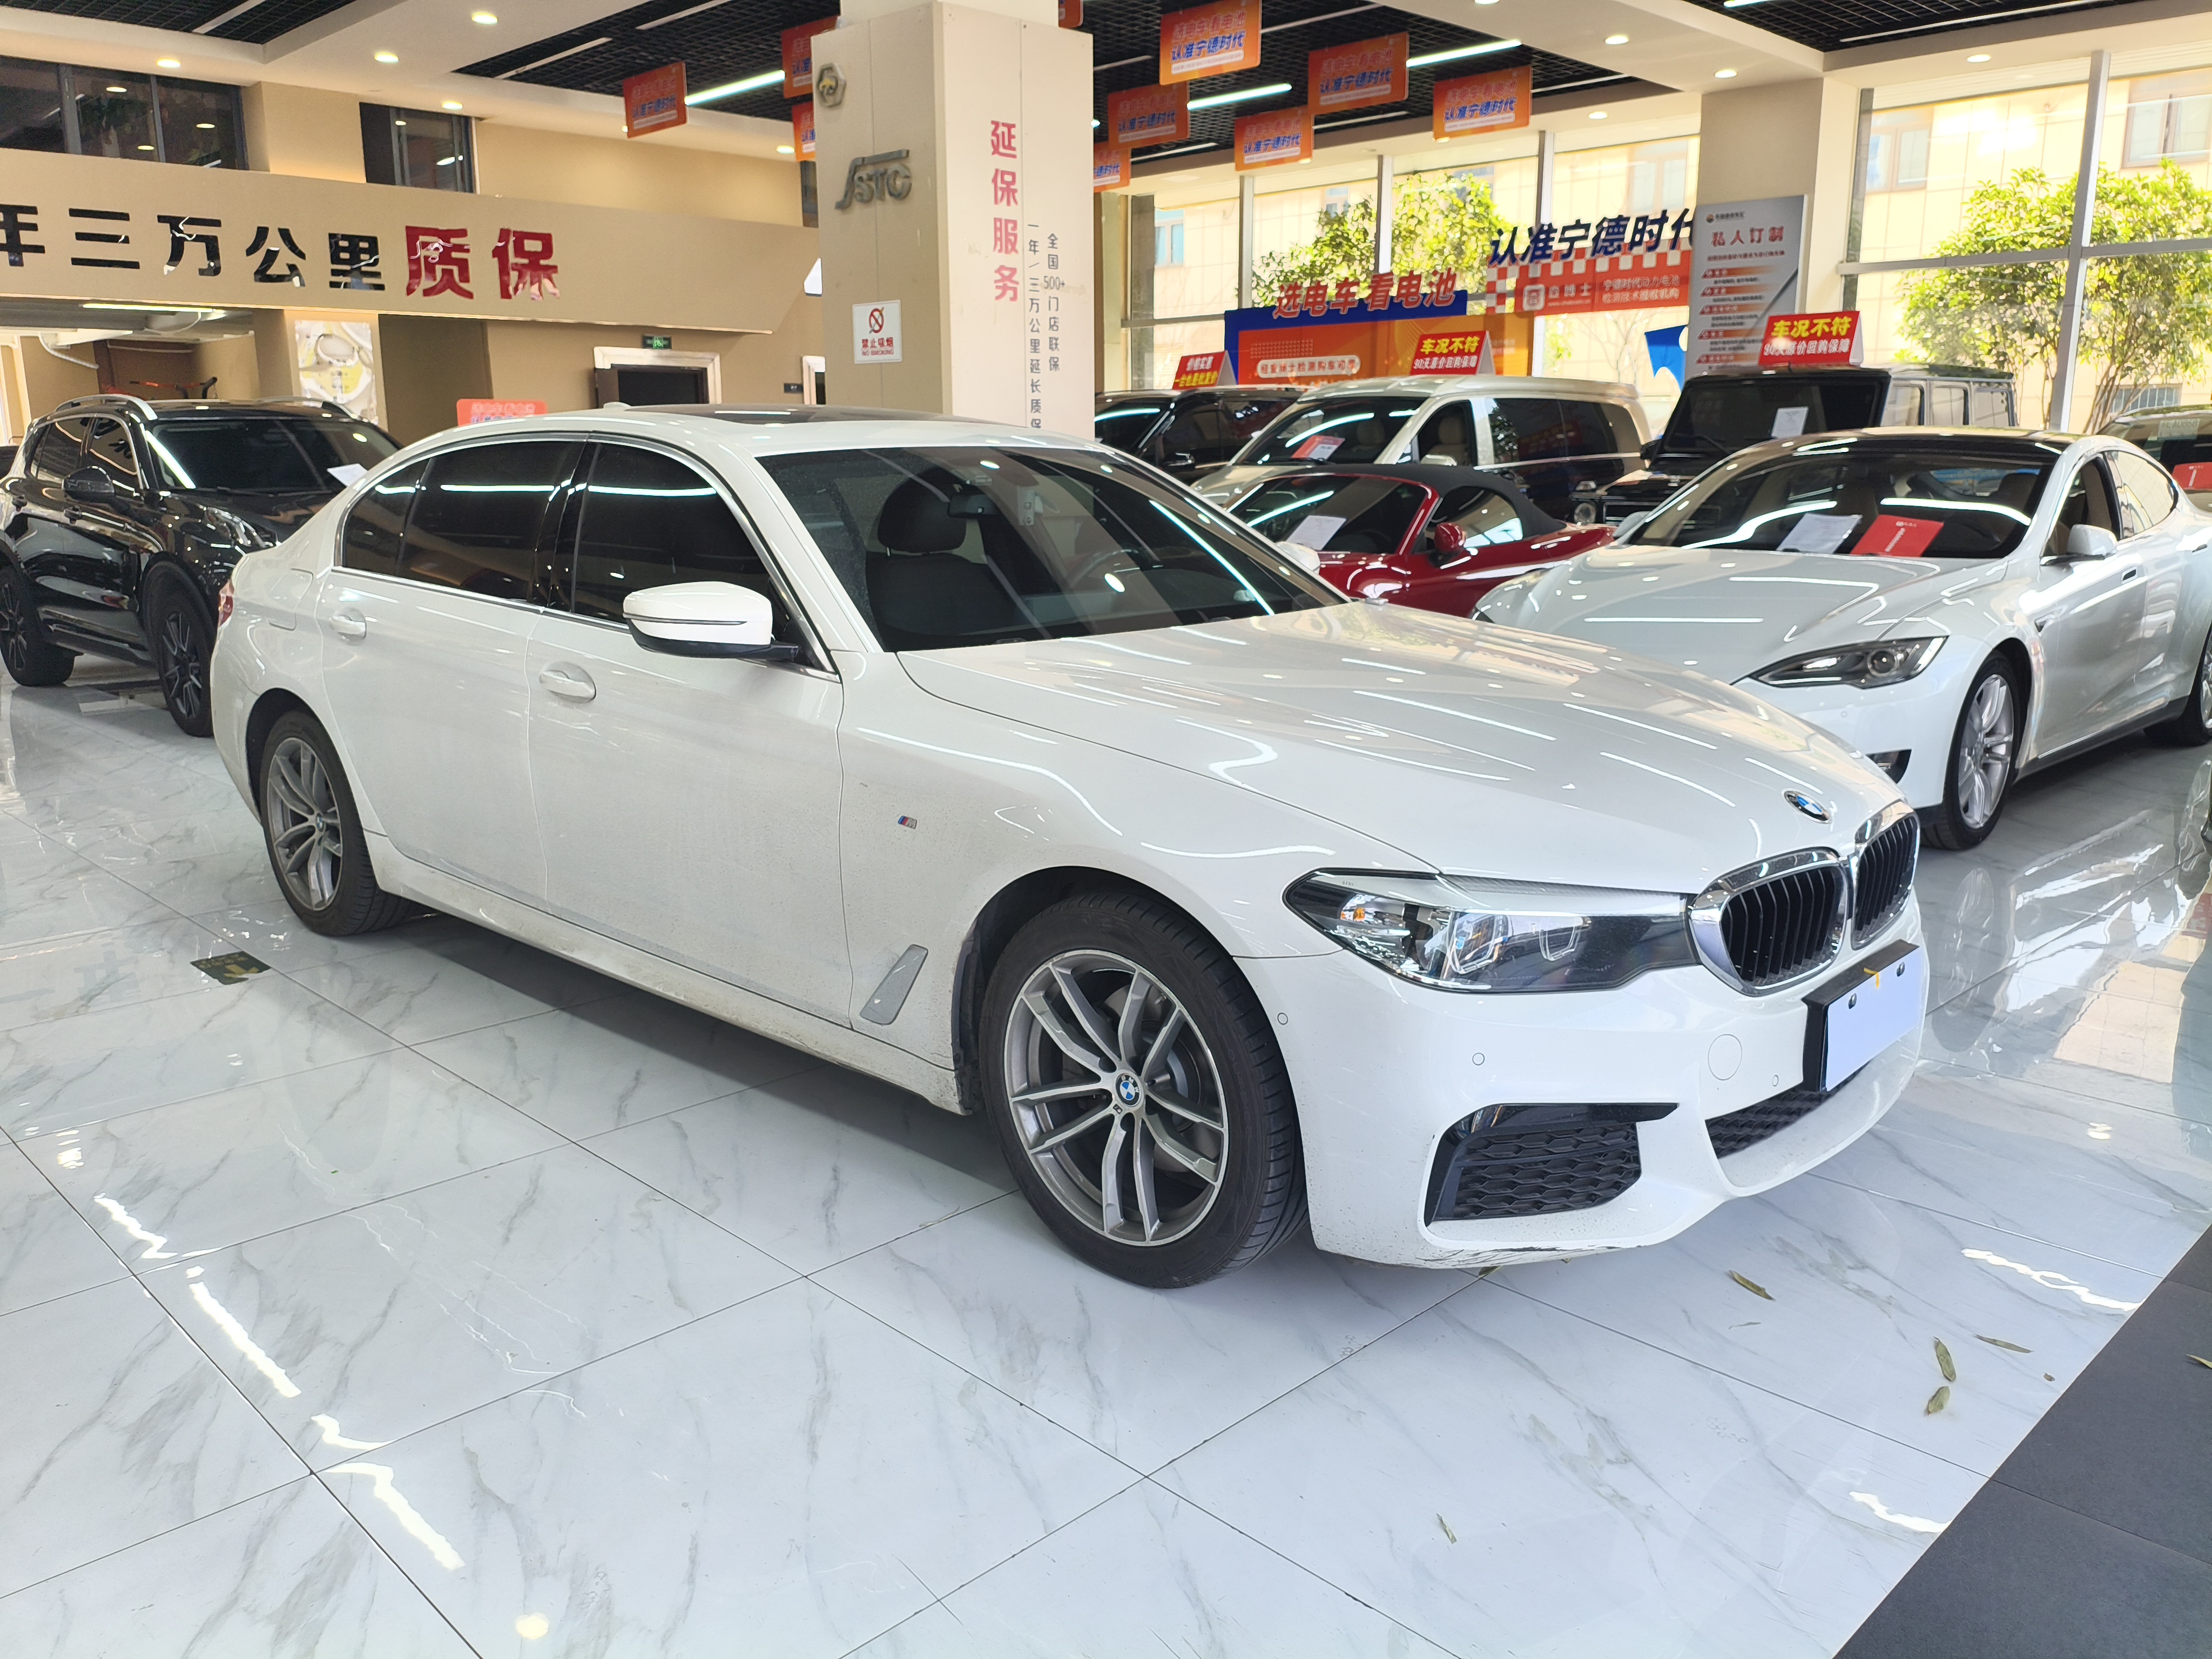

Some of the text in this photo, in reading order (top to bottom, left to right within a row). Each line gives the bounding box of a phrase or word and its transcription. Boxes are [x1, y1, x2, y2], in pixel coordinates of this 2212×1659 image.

[1170, 30, 1246, 62] 认准宁德时代
[1320, 66, 1393, 95] 认准宁德时代
[1117, 109, 1177, 132] 认准宁德时代
[1444, 96, 1517, 122] 认准宁德时代
[1244, 132, 1302, 154] 认准宁德时代
[990, 119, 1020, 302] 延保服务
[1711, 225, 1785, 247] 私人订制
[1273, 267, 1458, 320] 选电车看电池
[1603, 274, 1681, 292] 宁德时代动力电池
[1043, 233, 1065, 372] 全国500+门店联保
[1771, 316, 1853, 339] 车况不符
[862, 337, 894, 348] 禁止吸烟
[1420, 335, 1481, 355] 车况不符
[1763, 339, 1851, 356] 90天原价回购保障
[1121, 1075, 1139, 1093] BMW
